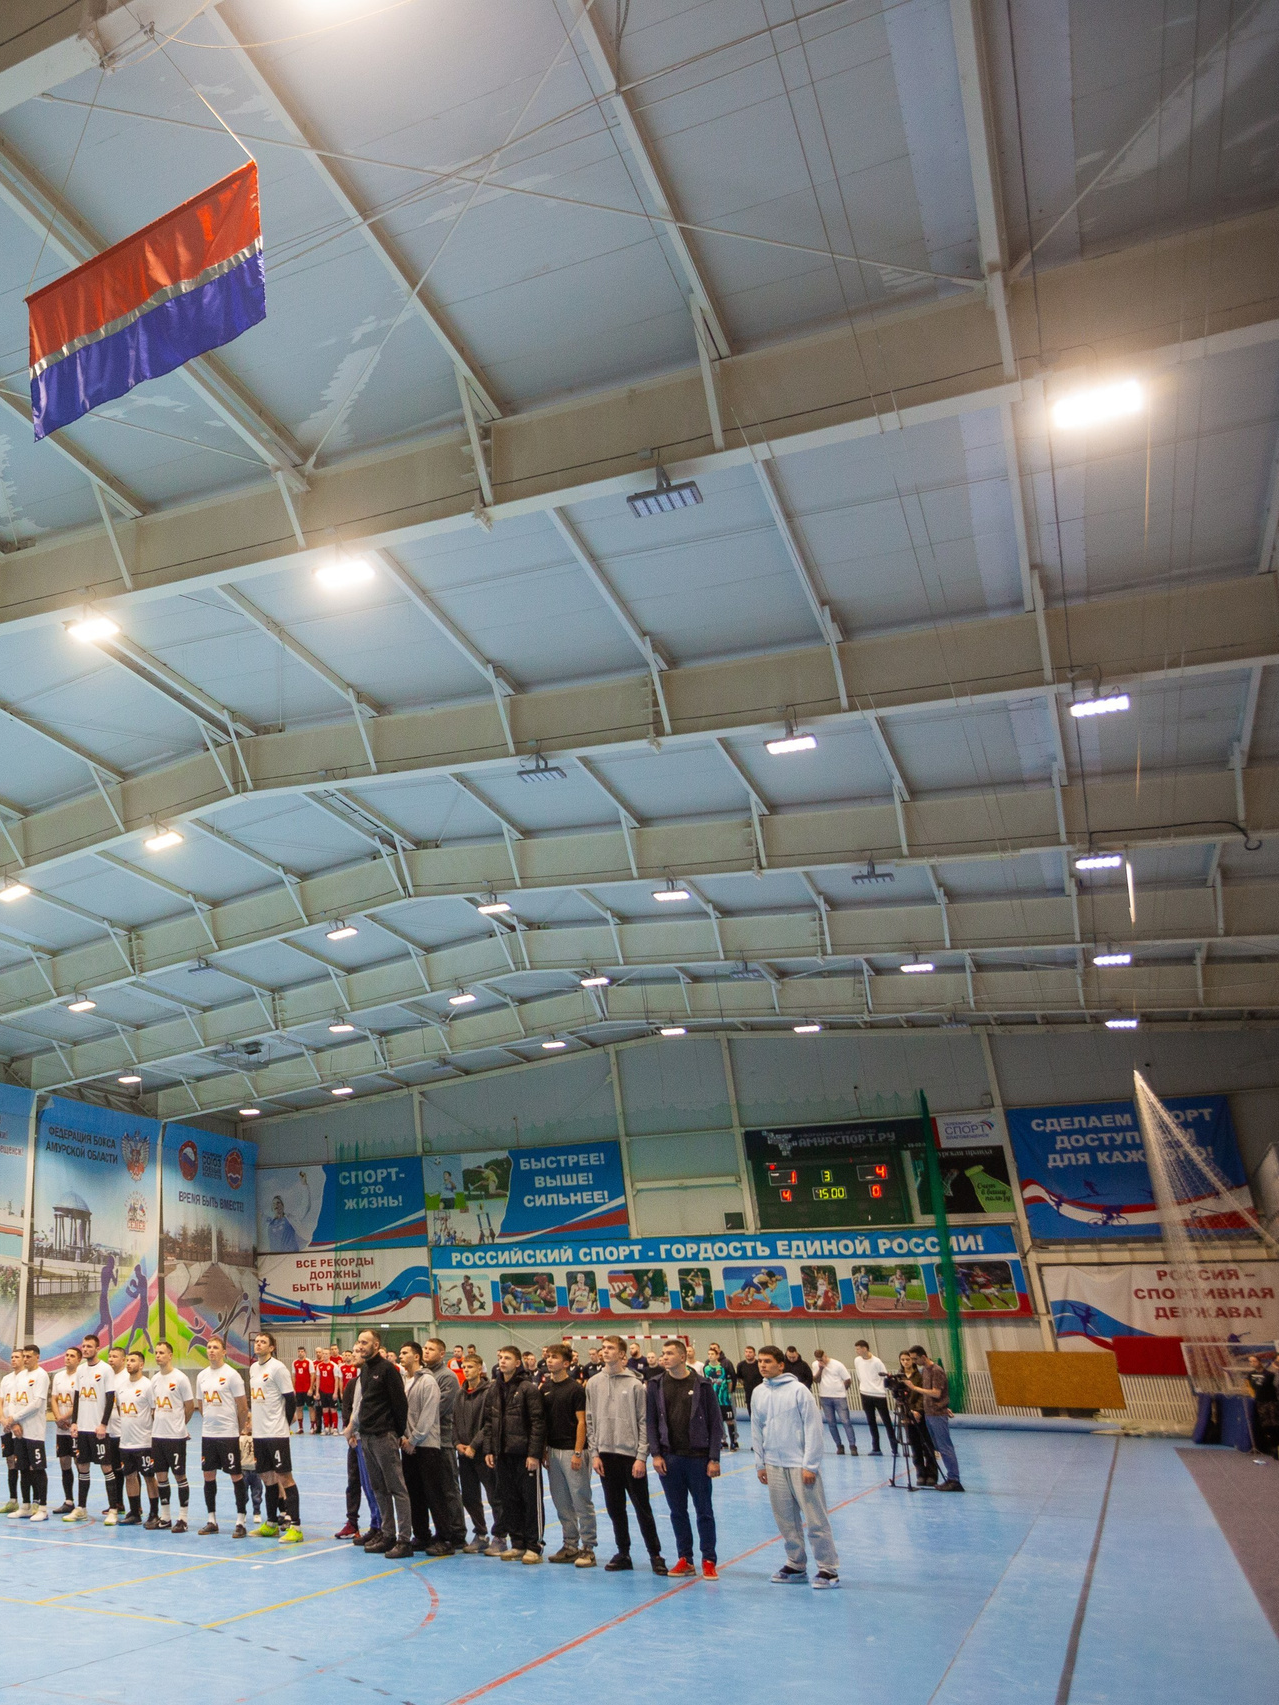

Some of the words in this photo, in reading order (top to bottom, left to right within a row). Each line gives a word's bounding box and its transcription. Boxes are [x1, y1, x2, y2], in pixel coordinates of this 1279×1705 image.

[944, 1124, 985, 1136] СПОРТ
[1031, 1113, 1132, 1133] СДЕЛАЕМ
[48, 1126, 92, 1145] ФЕДЕРАЦИЯ
[93, 1134, 117, 1149] БОКСА
[1055, 1127, 1197, 1150] ДОСТУПМ
[46, 1141, 86, 1159] АМУРСКОЙ
[87, 1148, 118, 1165] ОБЛАСТИ
[1047, 1151, 1091, 1168] ДЛЯ
[1097, 1146, 1214, 1164] КАЖОГО!
[519, 1152, 606, 1171] БЫСТРЕЕ!
[338, 1167, 406, 1187] СПОРТ-
[823, 1170, 831, 1182] 3
[875, 1164, 887, 1179] 4
[534, 1172, 594, 1189] ВЫШЕ!
[360, 1184, 384, 1196] ЭТО
[871, 1184, 881, 1198] 0
[178, 1190, 201, 1206] ВРЕМЯ
[201, 1195, 219, 1209] БЫТЬ
[344, 1195, 403, 1211] ЖИЗНЬ!
[523, 1190, 610, 1209] СИЛЬНЕЕ!
[451, 1245, 573, 1267] РОССИЙСКИЙ
[578, 1245, 643, 1264] СПОРТ
[659, 1240, 771, 1261] ГОРДОСТЬ
[777, 1235, 871, 1259] ЕДИНОЙ
[879, 1234, 985, 1255] РОССИИ!
[296, 1258, 317, 1269] ВСЕ
[319, 1256, 374, 1269] РЕКОРДЫ
[309, 1270, 362, 1282] ДОЛЖНЫ
[292, 1281, 323, 1293] БЫТЬ
[325, 1279, 381, 1292] НАШИМИ!
[1134, 1287, 1275, 1300] СПОРТИВНАЯ
[35, 1448, 41, 1460] 5
[96, 1444, 106, 1455] 10
[274, 1450, 281, 1462] 4
[141, 1456, 151, 1467] 19
[173, 1453, 180, 1465] 7
[228, 1453, 235, 1464] 9
